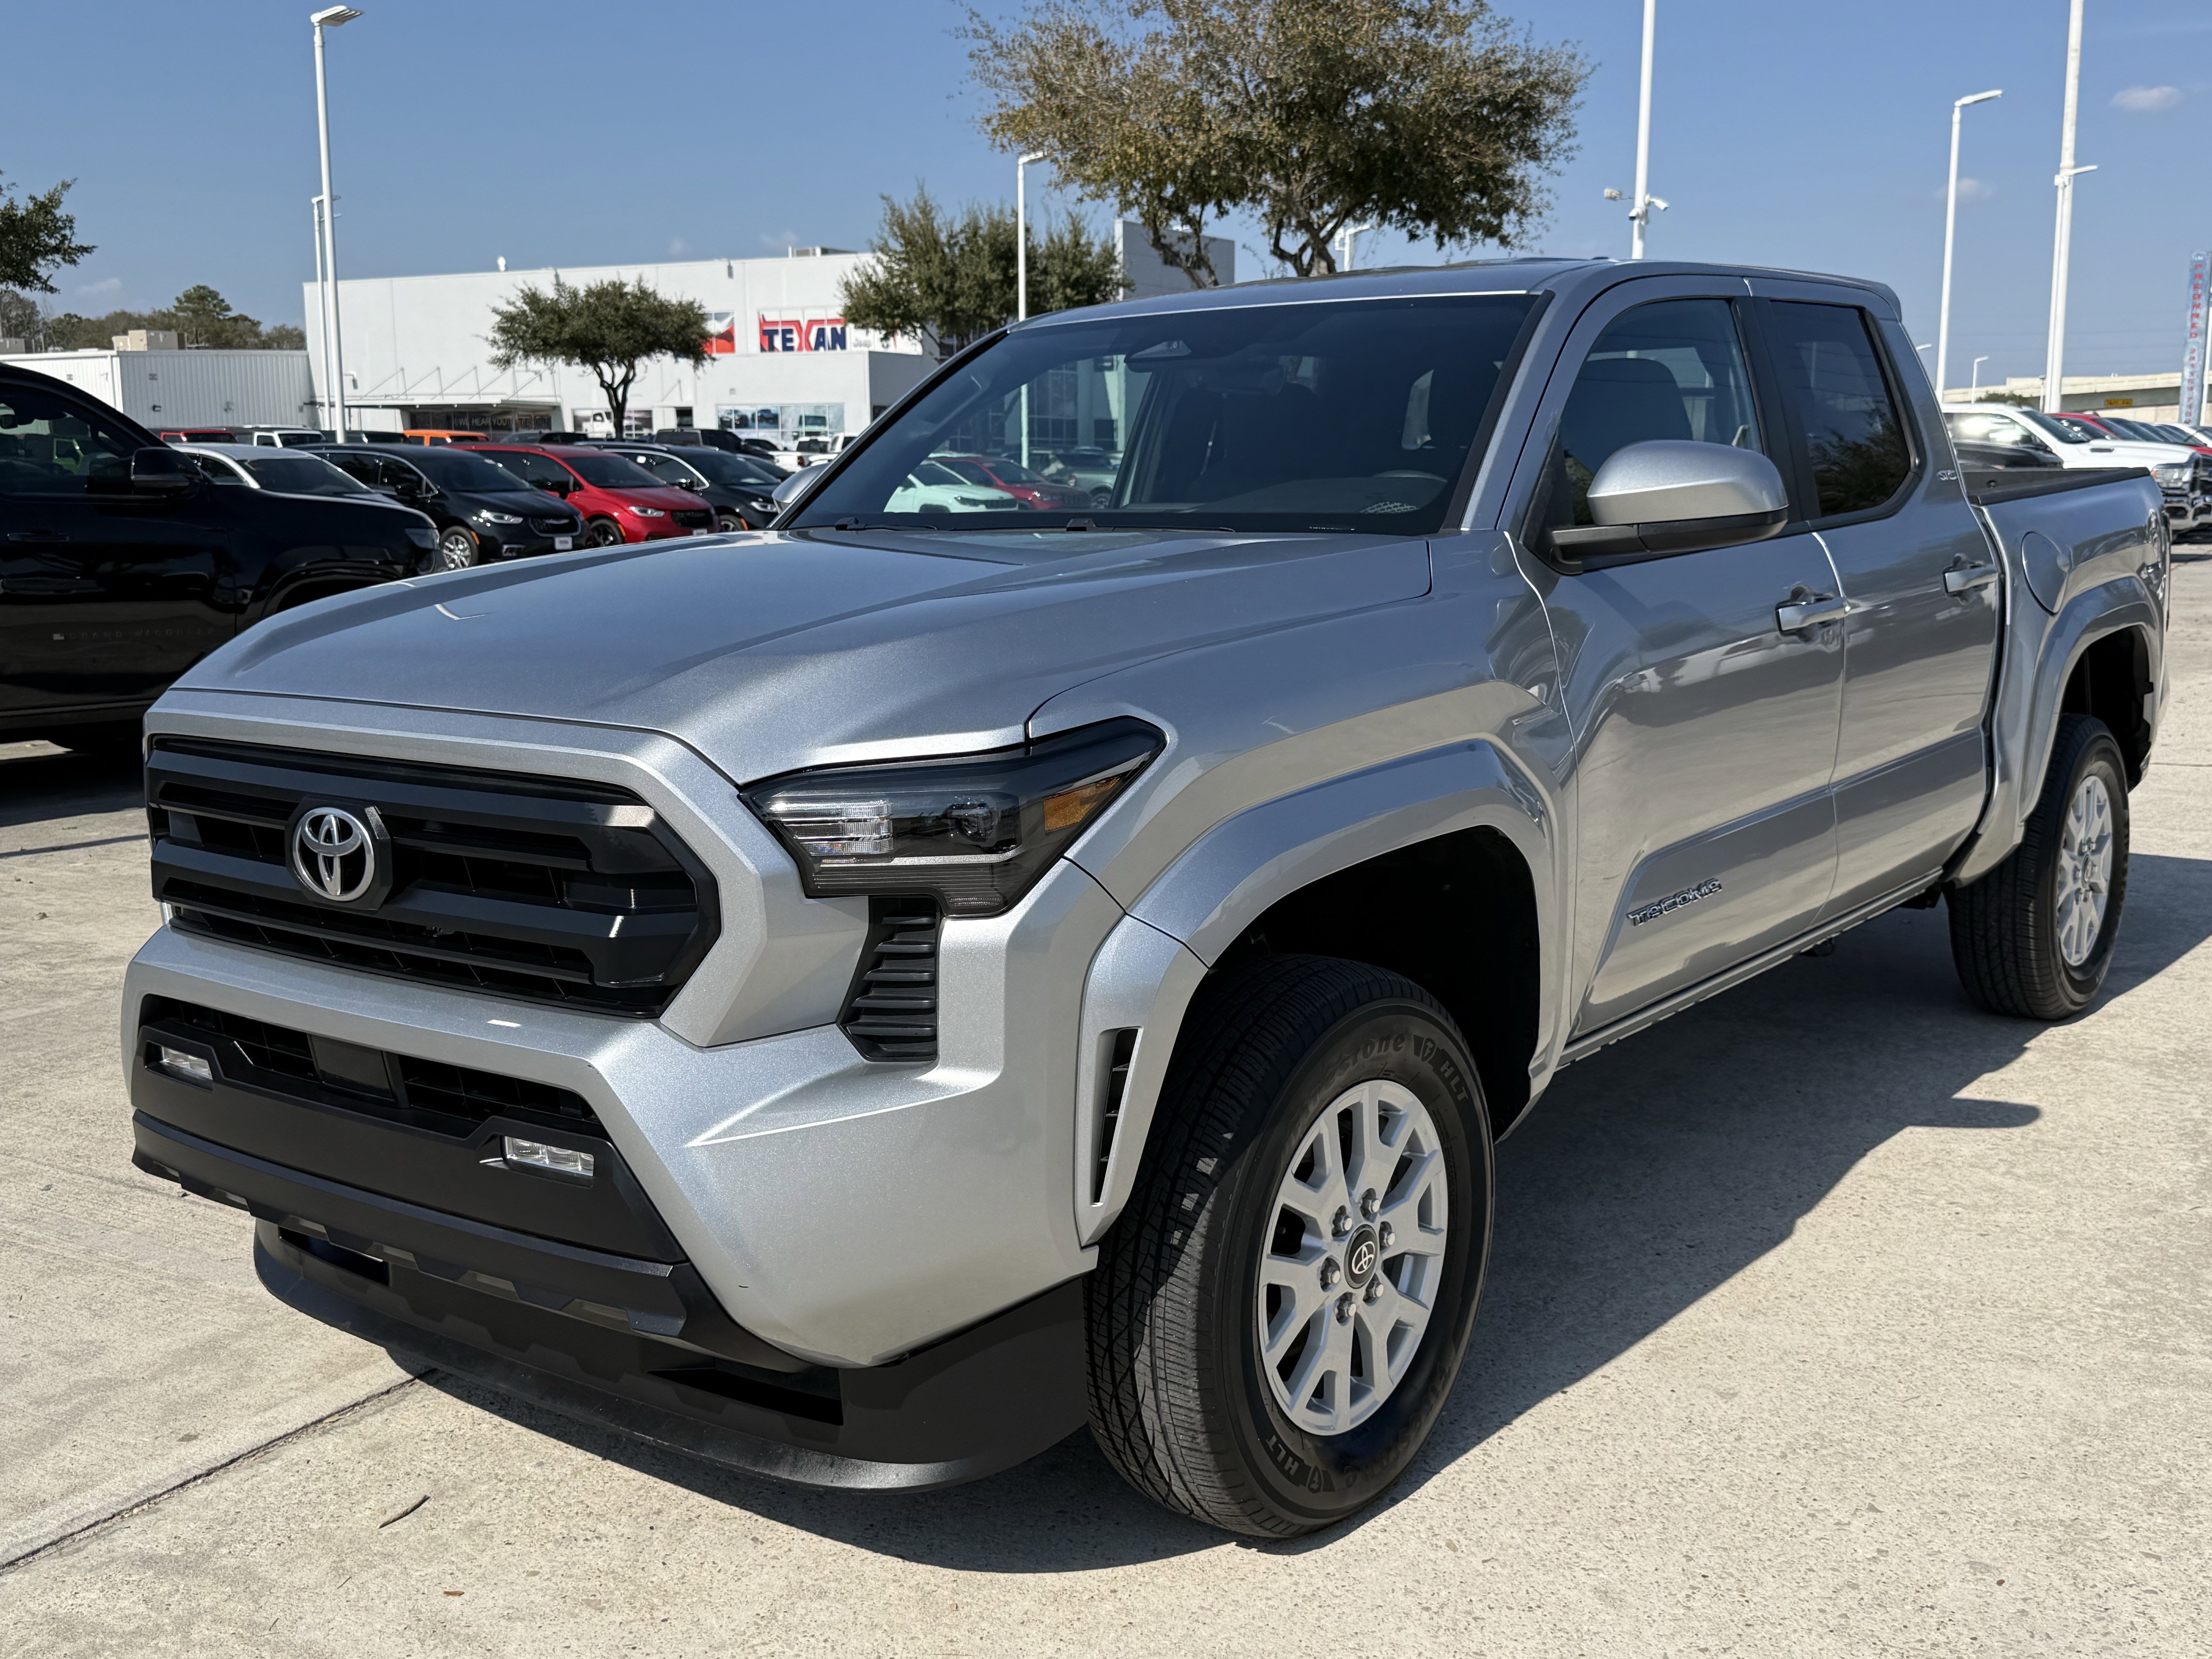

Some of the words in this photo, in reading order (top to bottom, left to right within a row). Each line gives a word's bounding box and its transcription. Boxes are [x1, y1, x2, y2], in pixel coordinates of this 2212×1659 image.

[760, 318, 847, 352] TEXAN
[69, 631, 122, 641] GRAND
[1626, 878, 1723, 926] TACOMA
[1439, 1060, 1469, 1102] HLT
[1265, 1434, 1300, 1475] HLT
